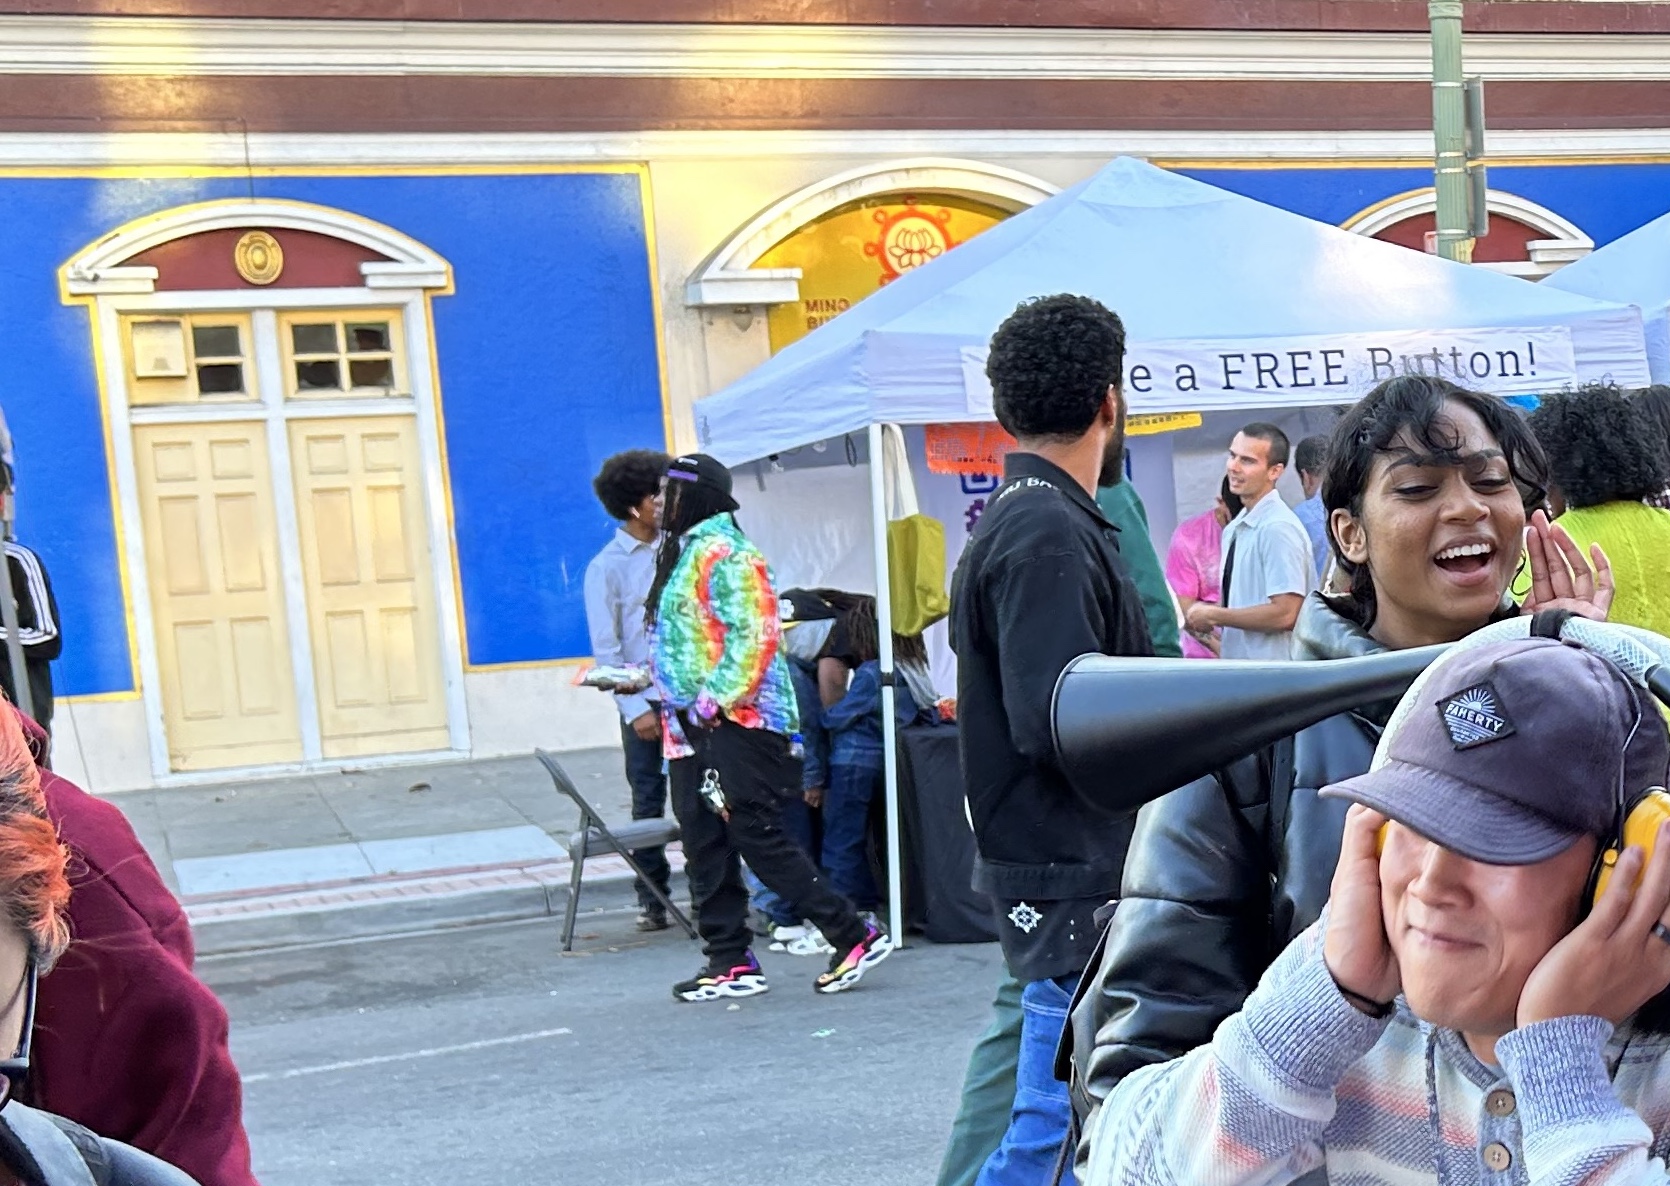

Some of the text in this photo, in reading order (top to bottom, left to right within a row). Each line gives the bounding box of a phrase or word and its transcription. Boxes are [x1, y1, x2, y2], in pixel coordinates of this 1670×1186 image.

[1175, 362, 1197, 391] a
[1219, 349, 1349, 390] FREE
[1366, 342, 1537, 383] Button!
[1445, 703, 1504, 732] FAHERTY
